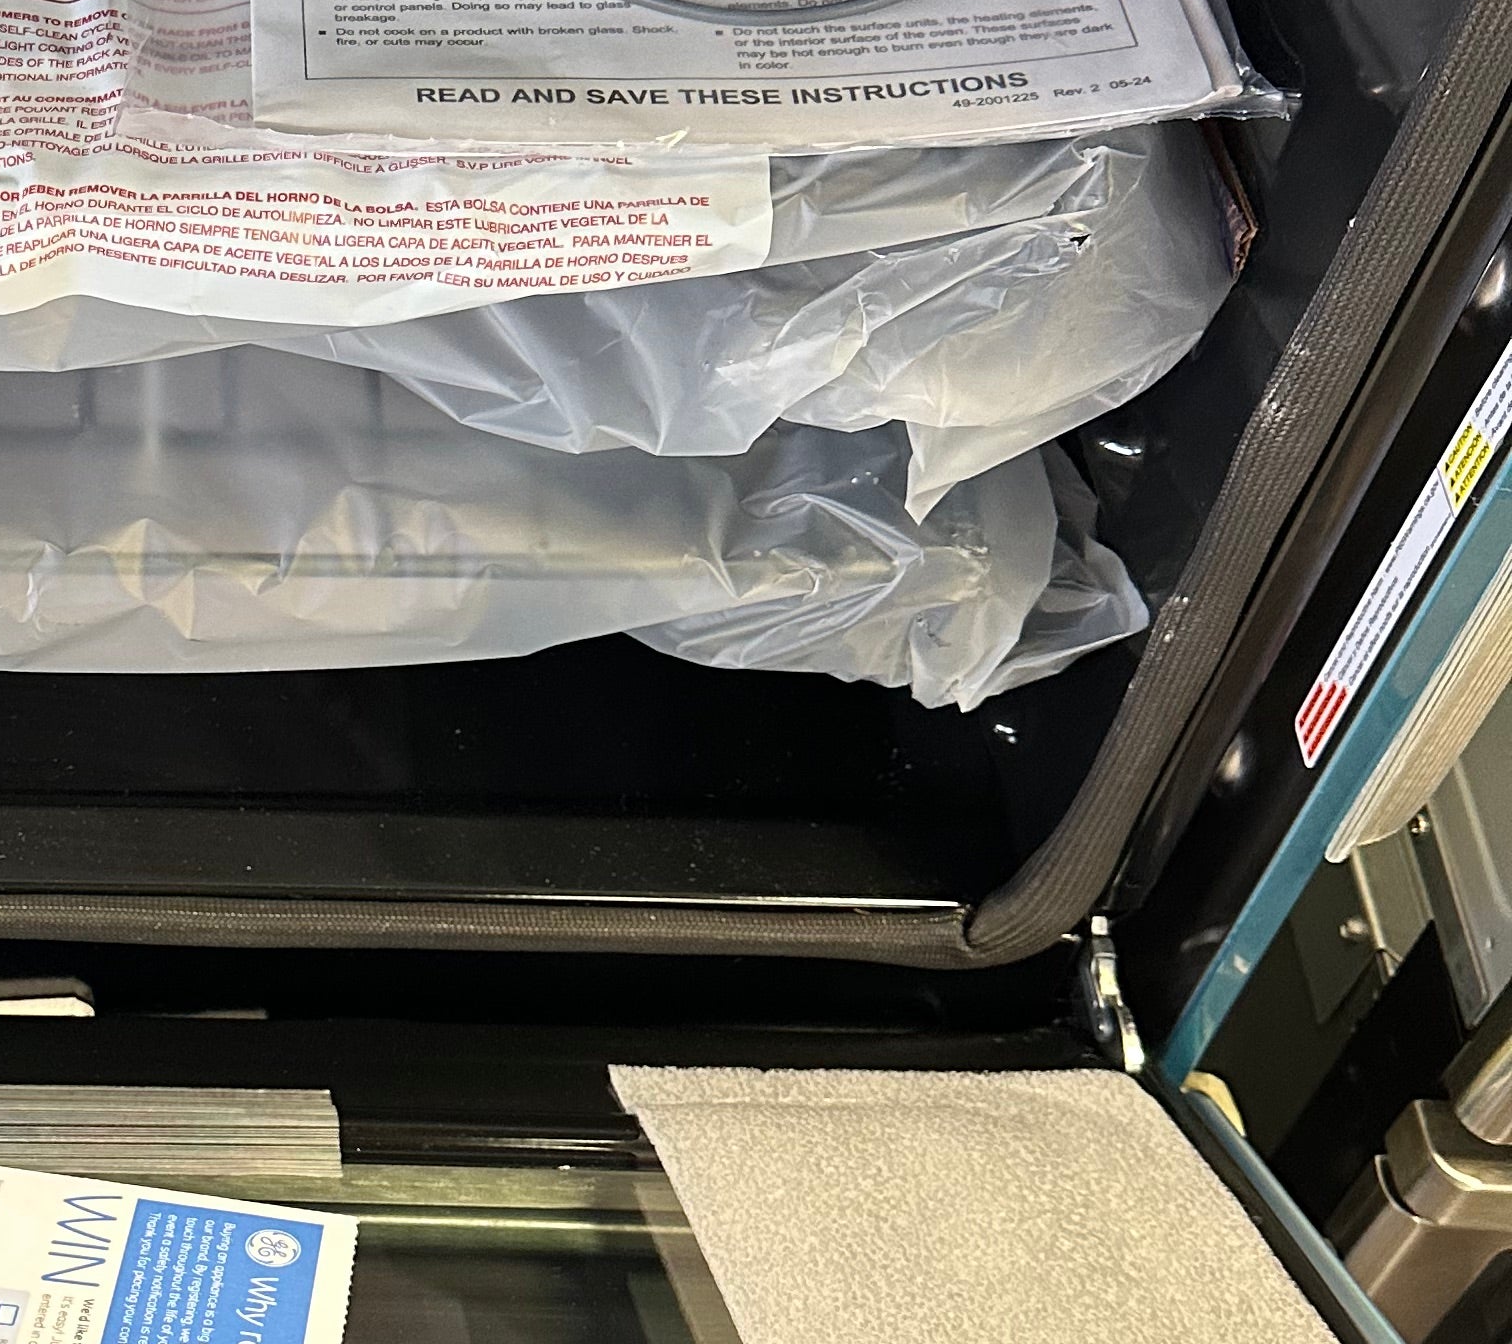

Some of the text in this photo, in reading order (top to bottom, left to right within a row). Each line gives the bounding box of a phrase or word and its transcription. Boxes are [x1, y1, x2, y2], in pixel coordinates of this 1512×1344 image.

[42, 16, 61, 26] TO
[63, 9, 118, 28] REMOVE
[334, 13, 399, 23] breakage.
[335, 27, 354, 35] Do
[358, 27, 380, 36] not
[383, 27, 415, 35] cook
[452, 27, 503, 37] product
[506, 26, 534, 35] with
[537, 26, 584, 34] broken
[588, 26, 624, 35] glass.
[336, 37, 360, 46] fire,
[414, 39, 442, 47] may
[416, 72, 1027, 104] READ AND SAVE THESE INSTRUCTIONS
[952, 75, 1152, 107] 49-2001225 Rev. 2 05-24
[68, 184, 136, 199] REMOVER
[140, 192, 159, 200] LA
[162, 191, 231, 200] PARRILLA
[235, 190, 263, 202] DEL
[266, 192, 319, 203] HORNO
[322, 194, 341, 207] DE
[344, 202, 362, 212] LA
[365, 201, 418, 214] BOLSA.
[425, 199, 459, 212] ESTA
[462, 198, 506, 214] BOLSA
[509, 200, 579, 216] CONTIENE
[583, 199, 614, 209] UNA
[617, 196, 686, 208] PARRILLA
[689, 196, 709, 206] DE
[144, 1212, 161, 1237] Thank
[41, 1195, 122, 1286] WIN
[139, 1237, 152, 1255] you
[216, 1222, 236, 1251] Buying
[136, 1256, 151, 1269] for
[216, 1251, 227, 1264] an
[125, 1269, 146, 1303] placing
[206, 1265, 224, 1308] appliance
[78, 1298, 94, 1322] We'd
[235, 1277, 278, 1326] Why
[122, 1303, 136, 1325] your
[204, 1309, 214, 1317] is
[73, 1323, 88, 1340] like
[196, 1326, 215, 1342] big
